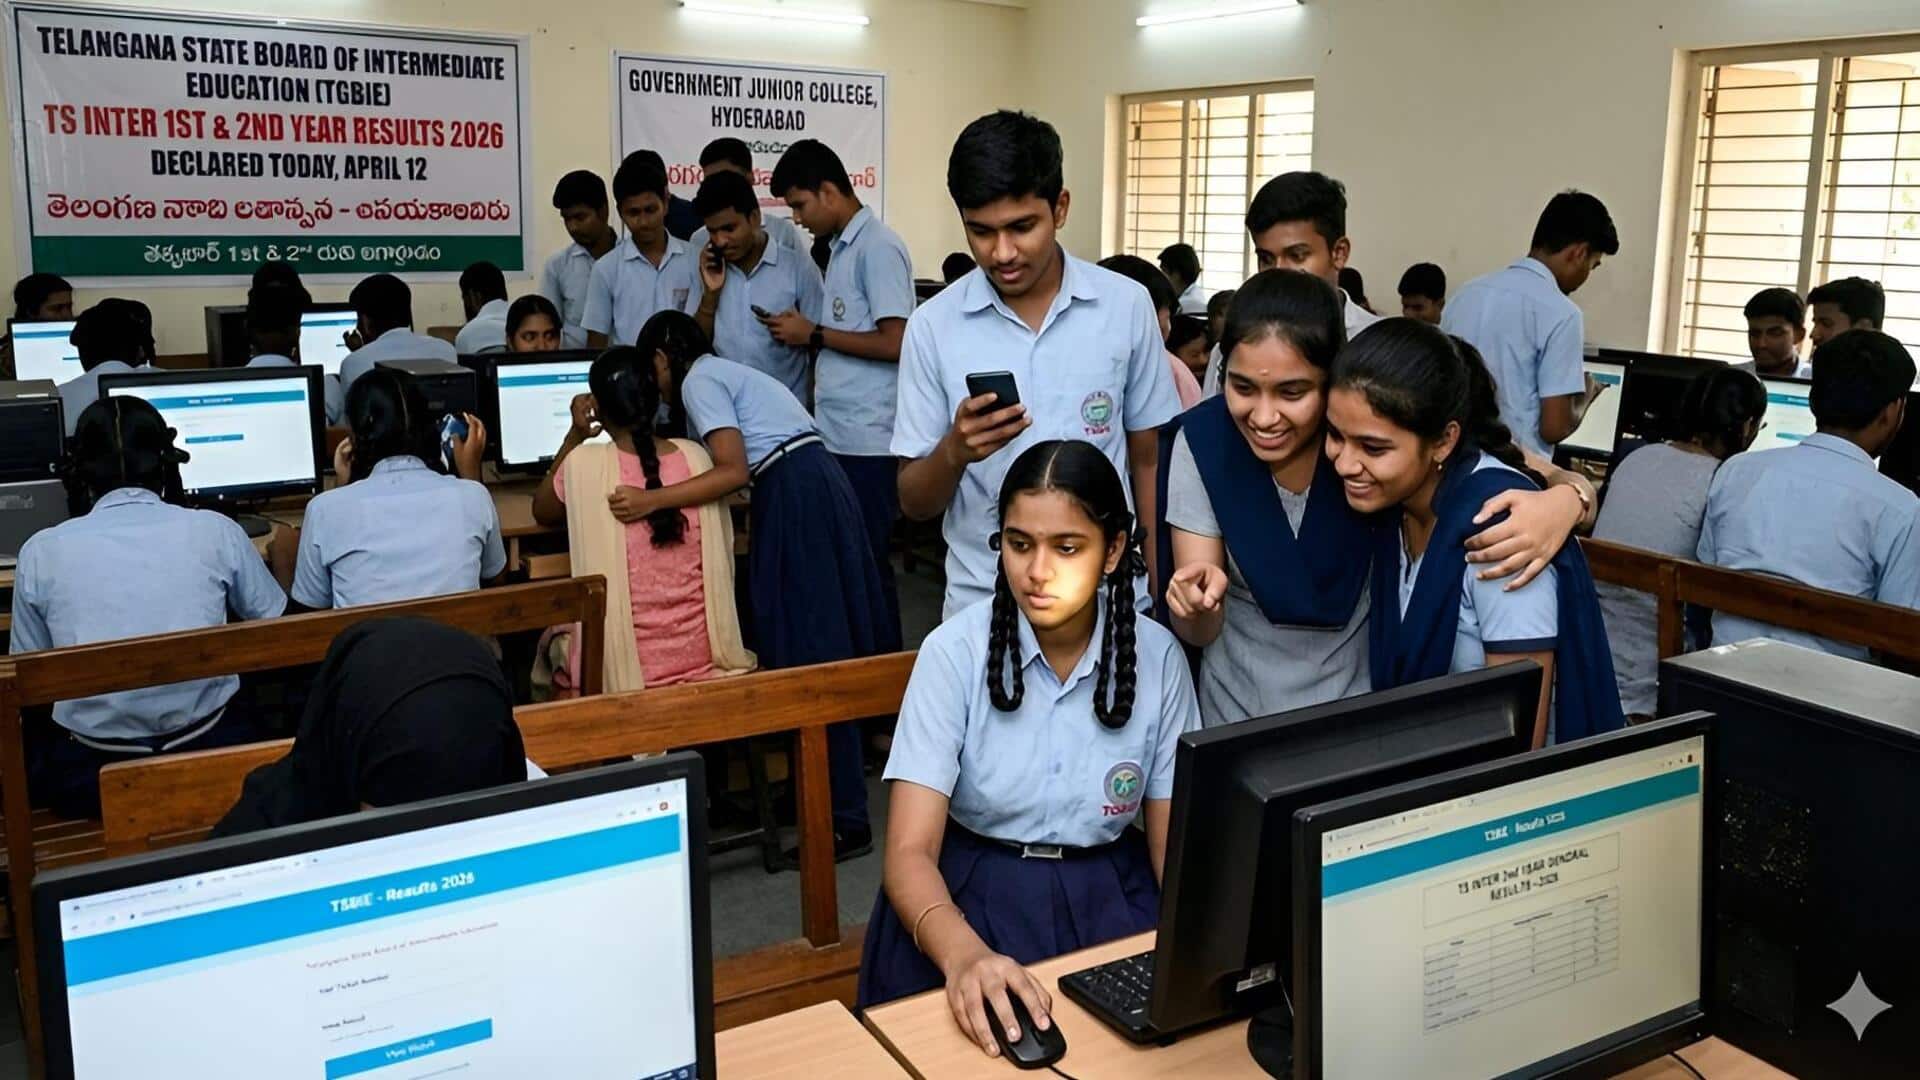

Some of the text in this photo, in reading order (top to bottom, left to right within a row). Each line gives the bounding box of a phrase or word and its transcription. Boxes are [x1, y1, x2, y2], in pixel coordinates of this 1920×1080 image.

[37, 26, 505, 81] TELANGANA STATE BOARD OF INTERMEDIATE
[186, 72, 310, 102] EDUCATION
[629, 69, 878, 108] GOVERNMENT JUNIOR COLLEGE,
[44, 105, 504, 149] TS INTER 1ST & 2ND YEAR RESULTS 2026
[711, 106, 806, 131] HYDERABAD
[151, 150, 428, 182] DECLARED TODAY, APRIL 12
